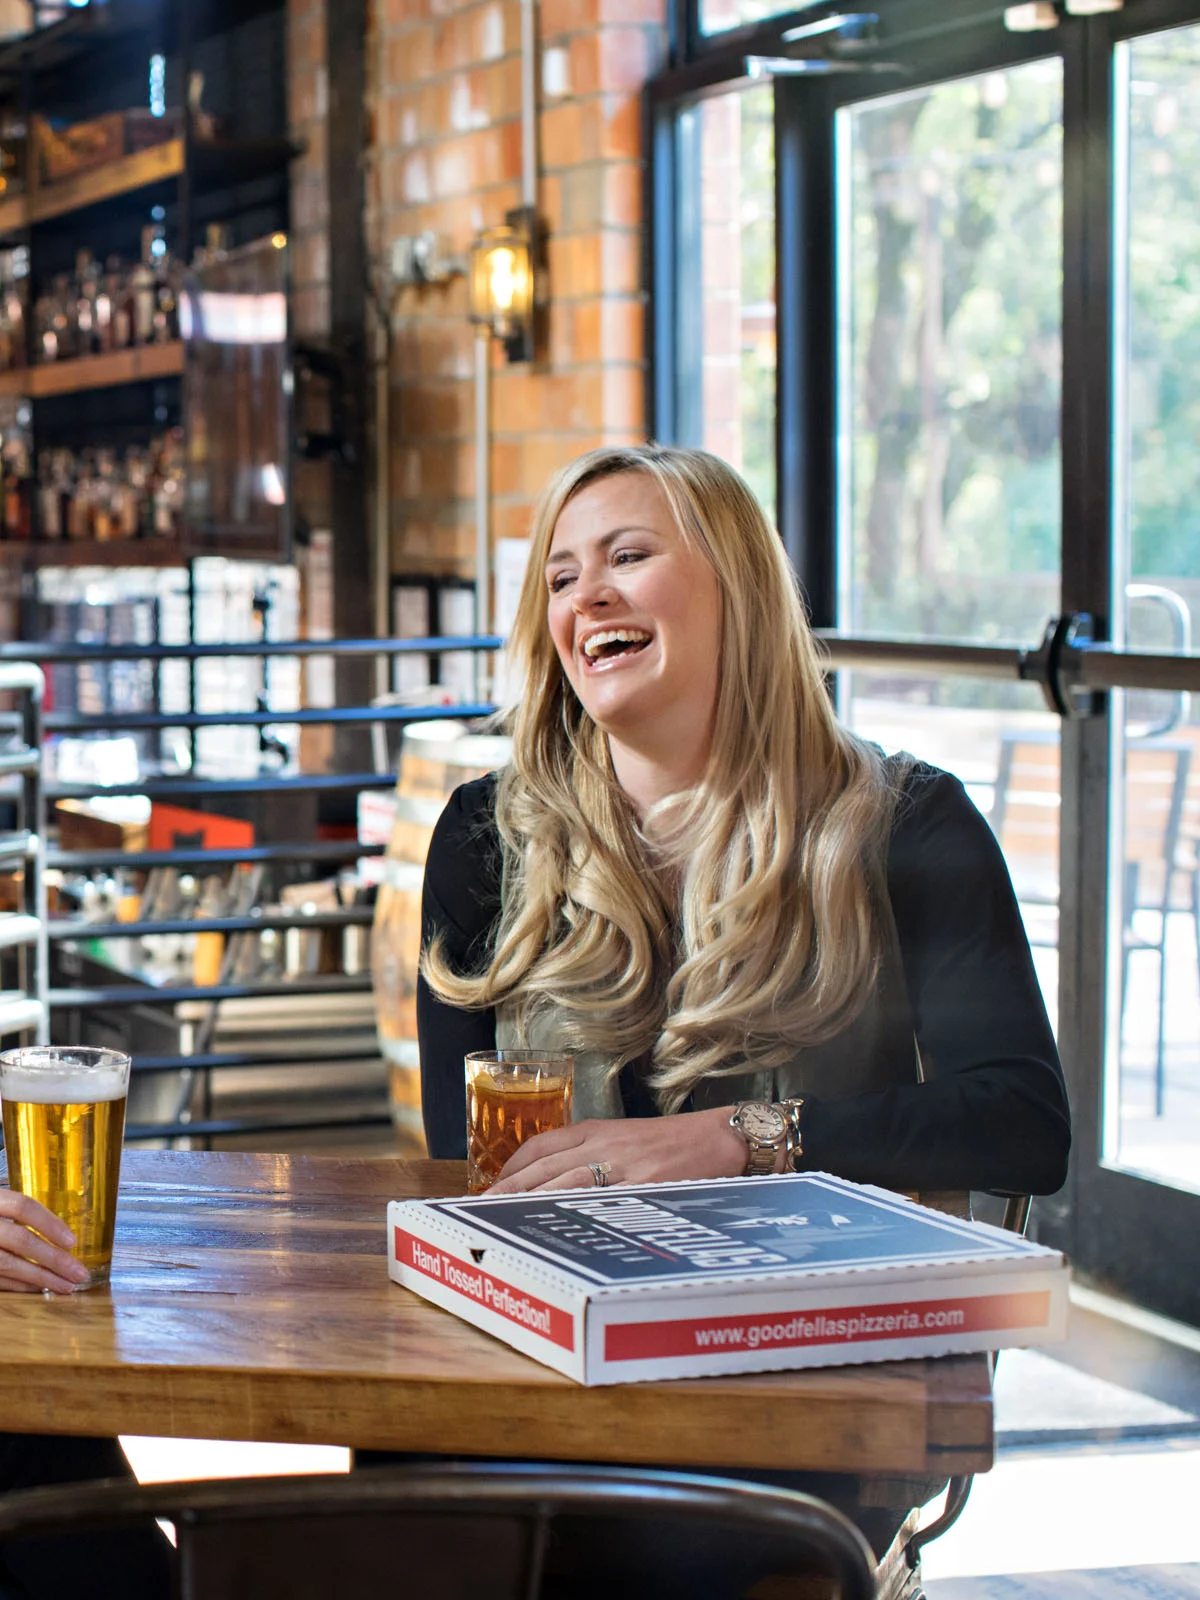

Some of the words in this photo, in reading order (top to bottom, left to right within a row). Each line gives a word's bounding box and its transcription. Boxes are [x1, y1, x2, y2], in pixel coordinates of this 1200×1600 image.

[524, 1213, 654, 1262] PIZZERIA
[555, 1196, 789, 1268] GOODFELLAS
[412, 1240, 441, 1277] Hand
[442, 1256, 483, 1299] Tossed
[484, 1278, 551, 1335] Perfection!
[694, 1309, 965, 1347] www.goodfellaspizzeria.com
